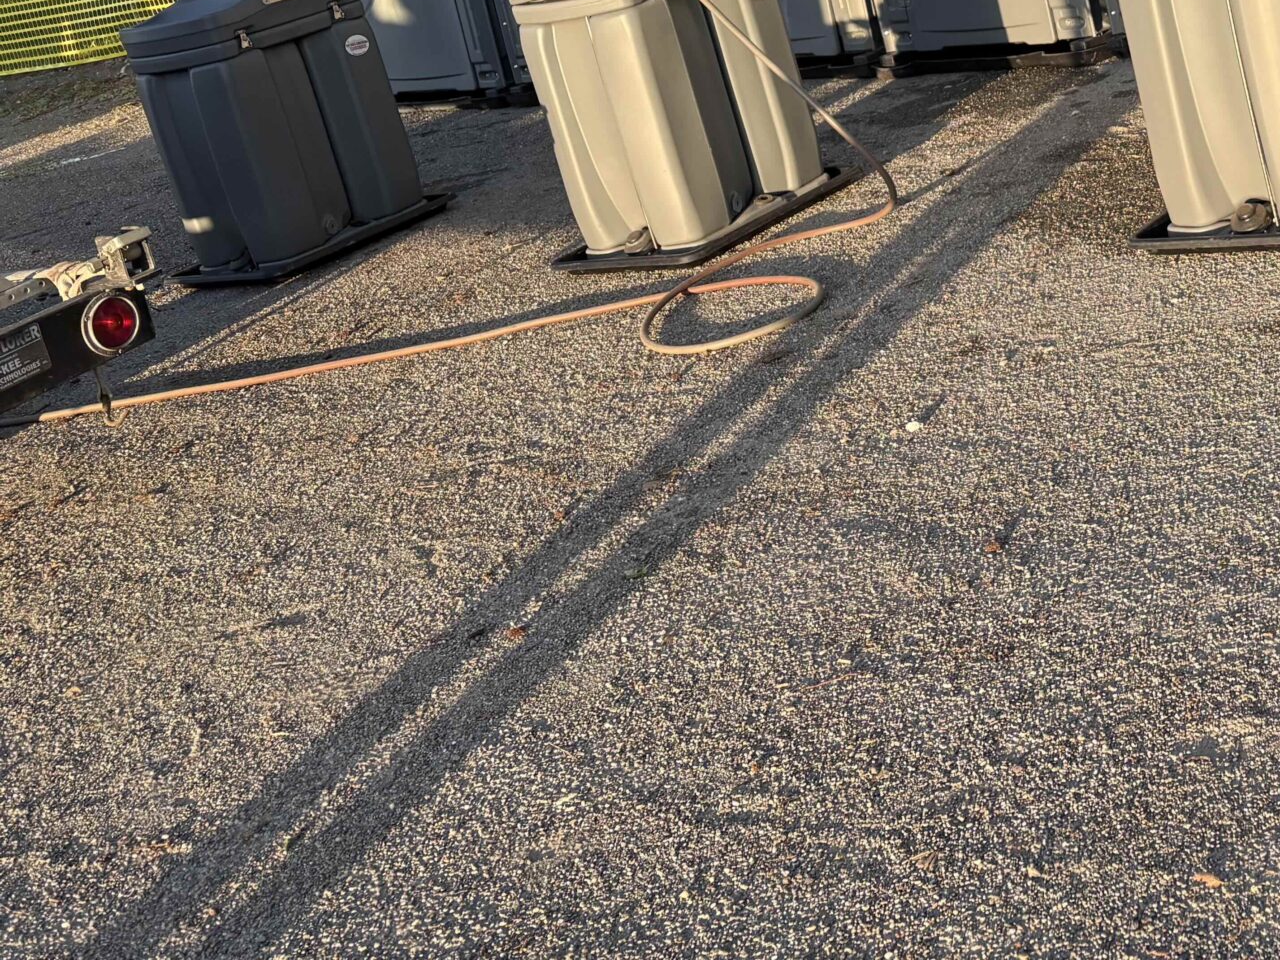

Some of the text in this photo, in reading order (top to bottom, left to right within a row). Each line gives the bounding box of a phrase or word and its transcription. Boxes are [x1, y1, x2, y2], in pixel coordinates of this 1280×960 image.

[0, 325, 41, 353] LORER
[0, 358, 22, 374] KEE
[0, 360, 40, 383] CHNOLOGIES
